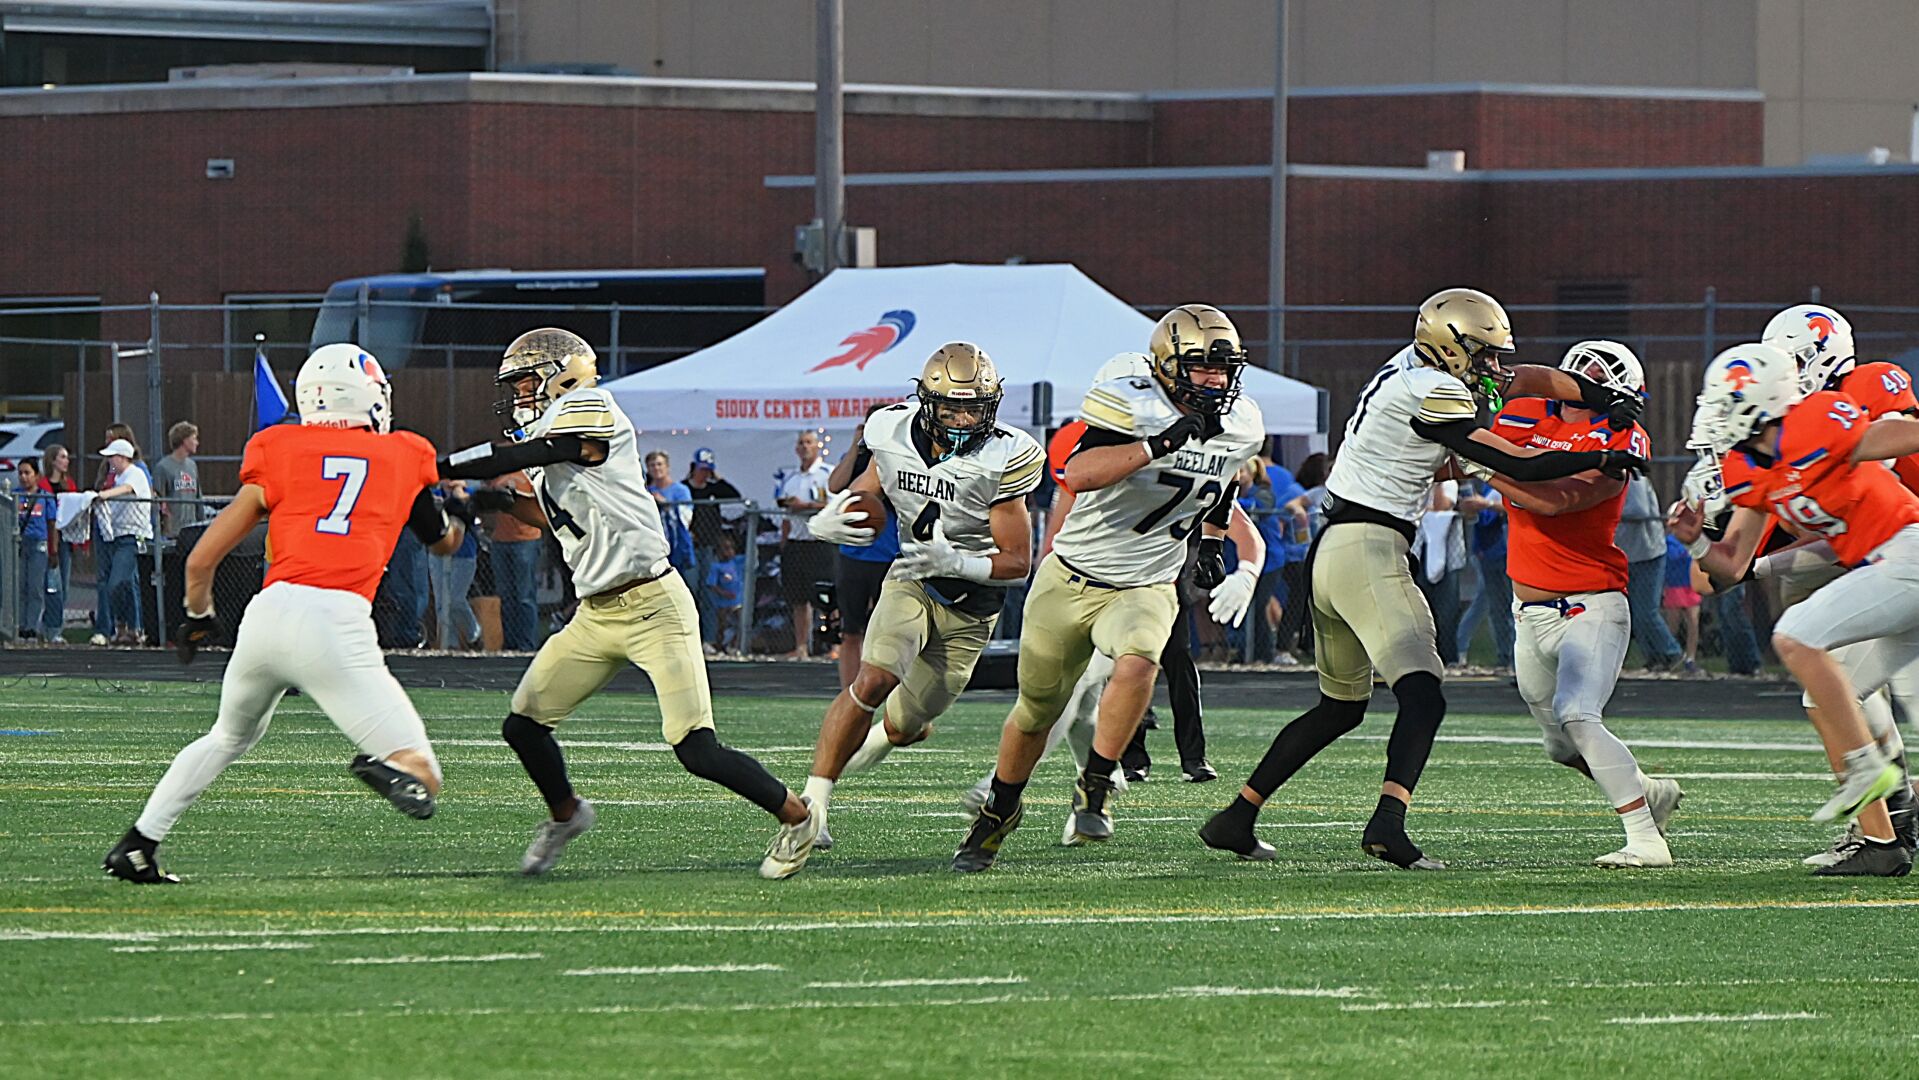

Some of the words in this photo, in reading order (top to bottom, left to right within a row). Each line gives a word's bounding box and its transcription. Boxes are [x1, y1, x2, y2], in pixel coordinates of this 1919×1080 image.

[1880, 370, 1908, 396] 40
[716, 399, 759, 418] SIOUX
[764, 399, 821, 418] CENTER
[827, 397, 905, 417] WARR
[1827, 401, 1860, 430] 19
[1627, 430, 1648, 460] 51
[1173, 449, 1228, 477] HEELAN
[315, 456, 369, 536] 7
[897, 470, 956, 502] HEELAN
[911, 500, 942, 541] 4
[1132, 471, 1223, 541] 73
